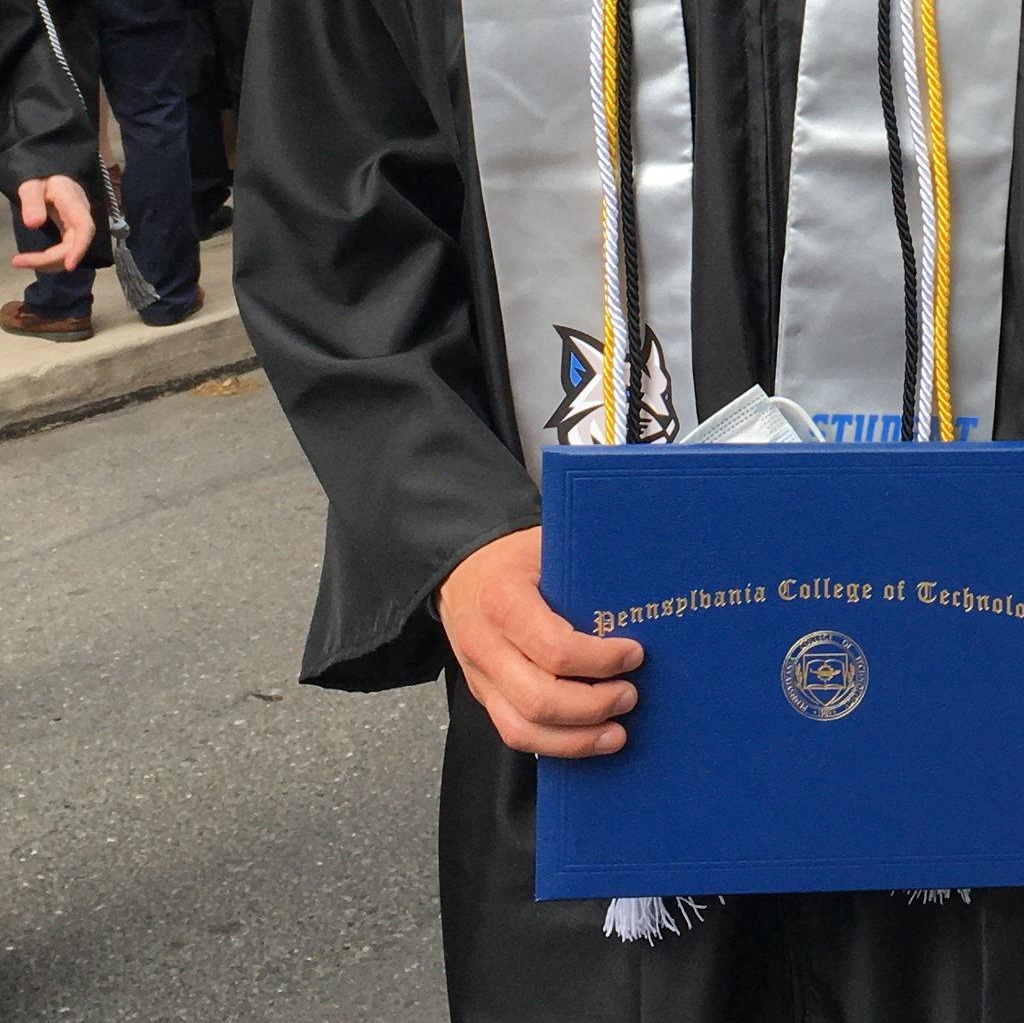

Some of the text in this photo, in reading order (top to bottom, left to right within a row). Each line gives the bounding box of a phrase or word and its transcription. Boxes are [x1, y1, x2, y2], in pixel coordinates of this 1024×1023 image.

[810, 413, 980, 442] STUDT
[592, 584, 767, 637] Pennsylvania
[777, 577, 873, 605] College
[882, 579, 907, 602] of
